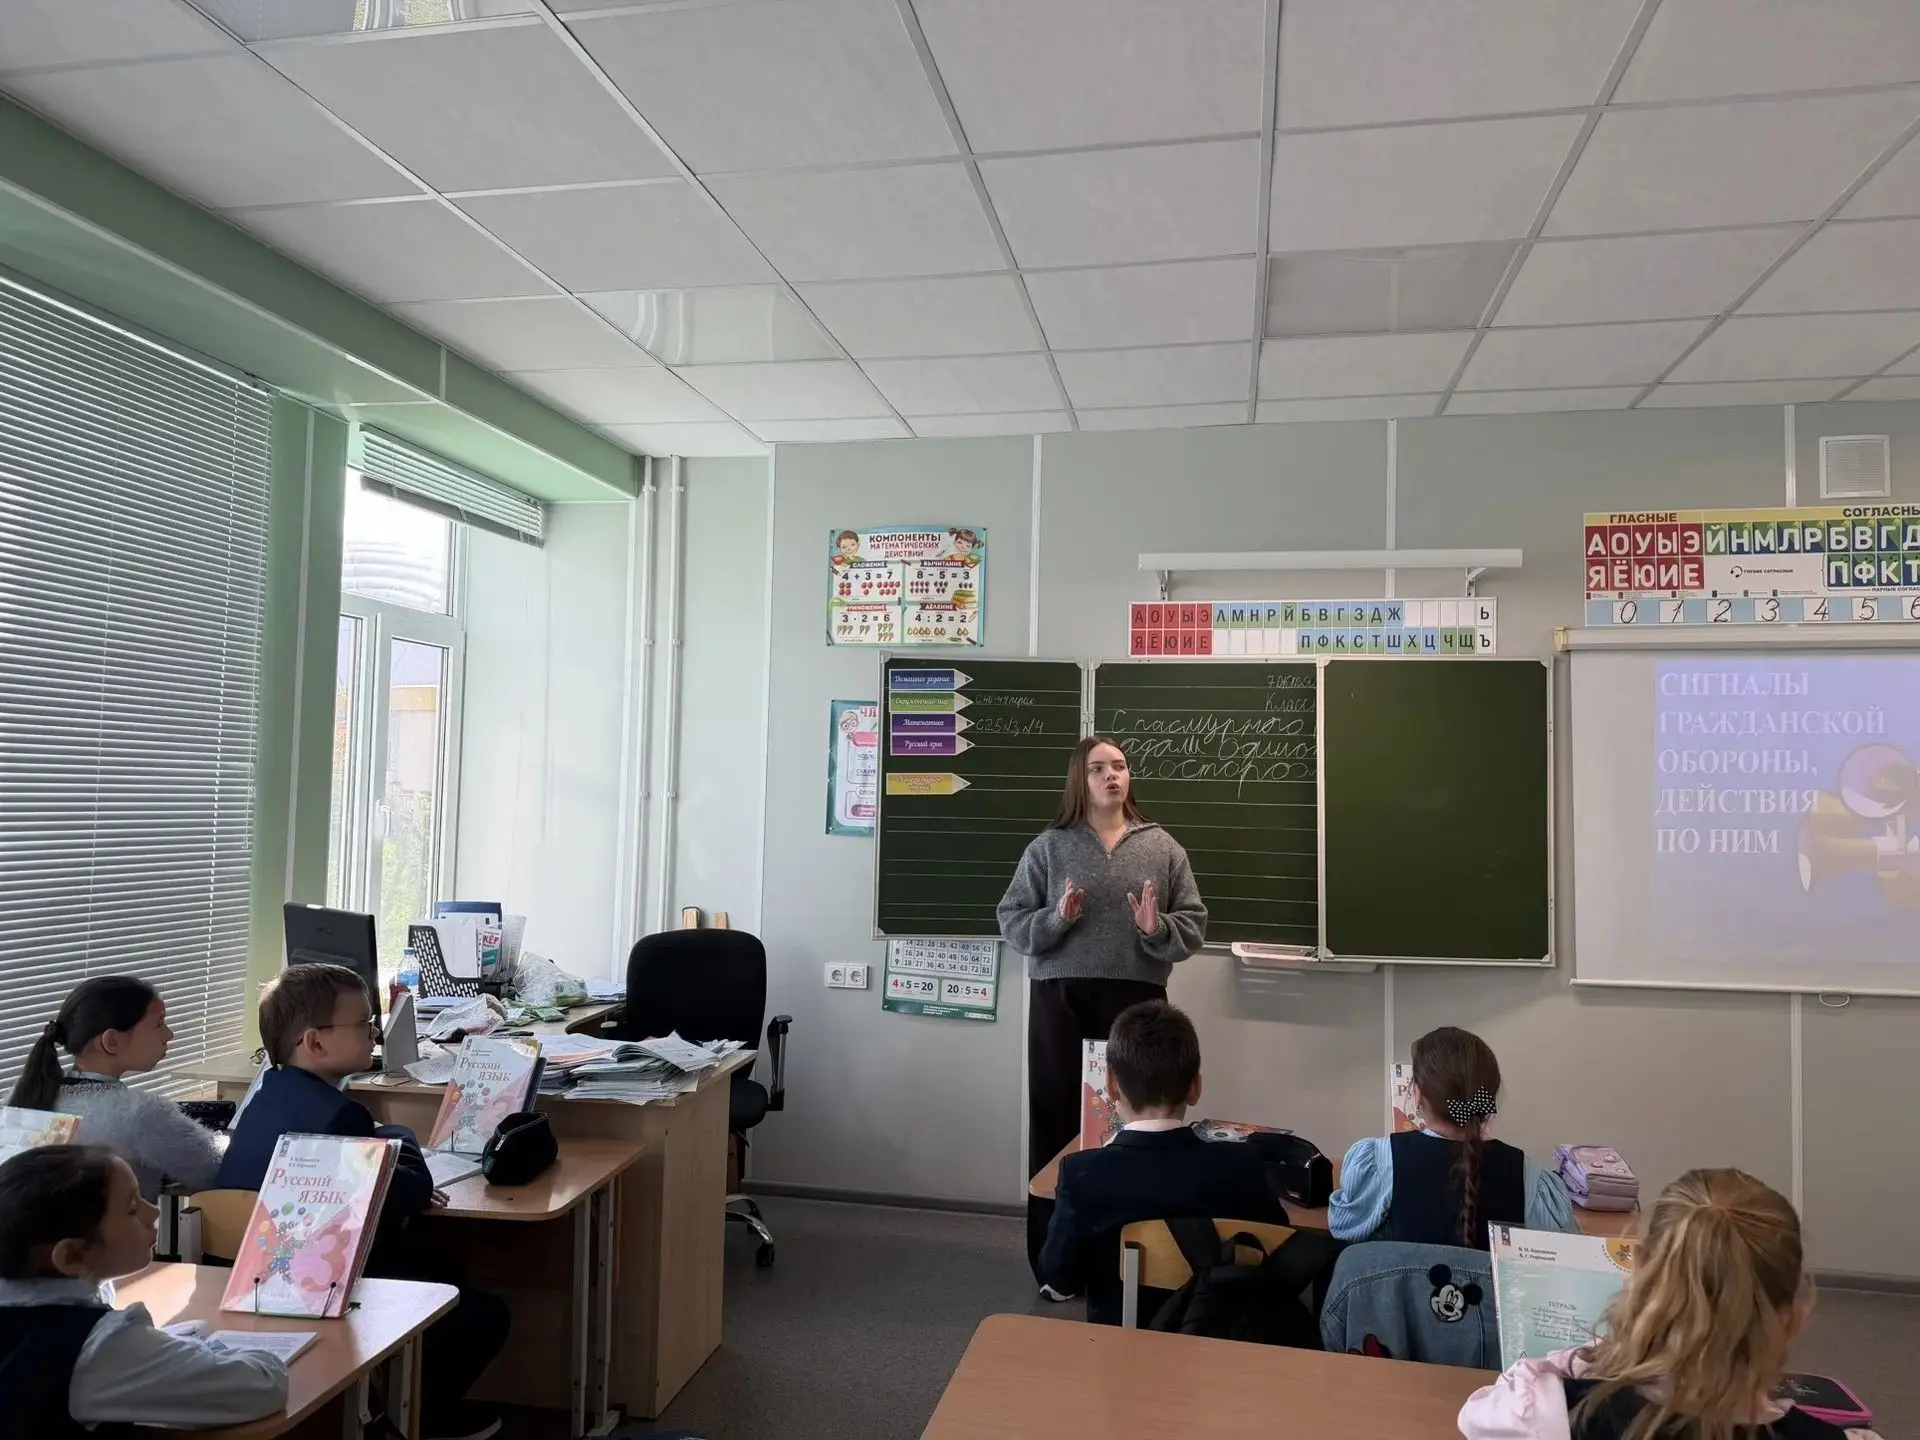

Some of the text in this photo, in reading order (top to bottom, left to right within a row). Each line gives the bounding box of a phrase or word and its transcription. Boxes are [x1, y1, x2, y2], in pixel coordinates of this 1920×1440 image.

[1610, 512, 1678, 523] ГЛАСНЫЕ
[869, 533, 941, 543] КОМПОНЕНТЫ
[870, 542, 940, 550] МАТЕМАТИЧЕСКИХ
[1620, 596, 1920, 623] 0 1 2 3 4 5 6
[1659, 672, 1810, 696] СИГНАЛЫ
[902, 718, 945, 727] Математика
[1659, 706, 1887, 737] ГРАЖДАНСКОЙ
[904, 740, 943, 750] Русский язык
[1657, 748, 1818, 777] ОБОРОНЫ,
[1655, 783, 1822, 815] ДЕЙСТВИЯ
[1655, 828, 1780, 854] ПО НИМ
[459, 1056, 501, 1071] Русский
[477, 1071, 512, 1082] ЯЗЫК
[270, 1167, 332, 1189] Русский
[296, 1189, 348, 1205] ЯЗЫК
